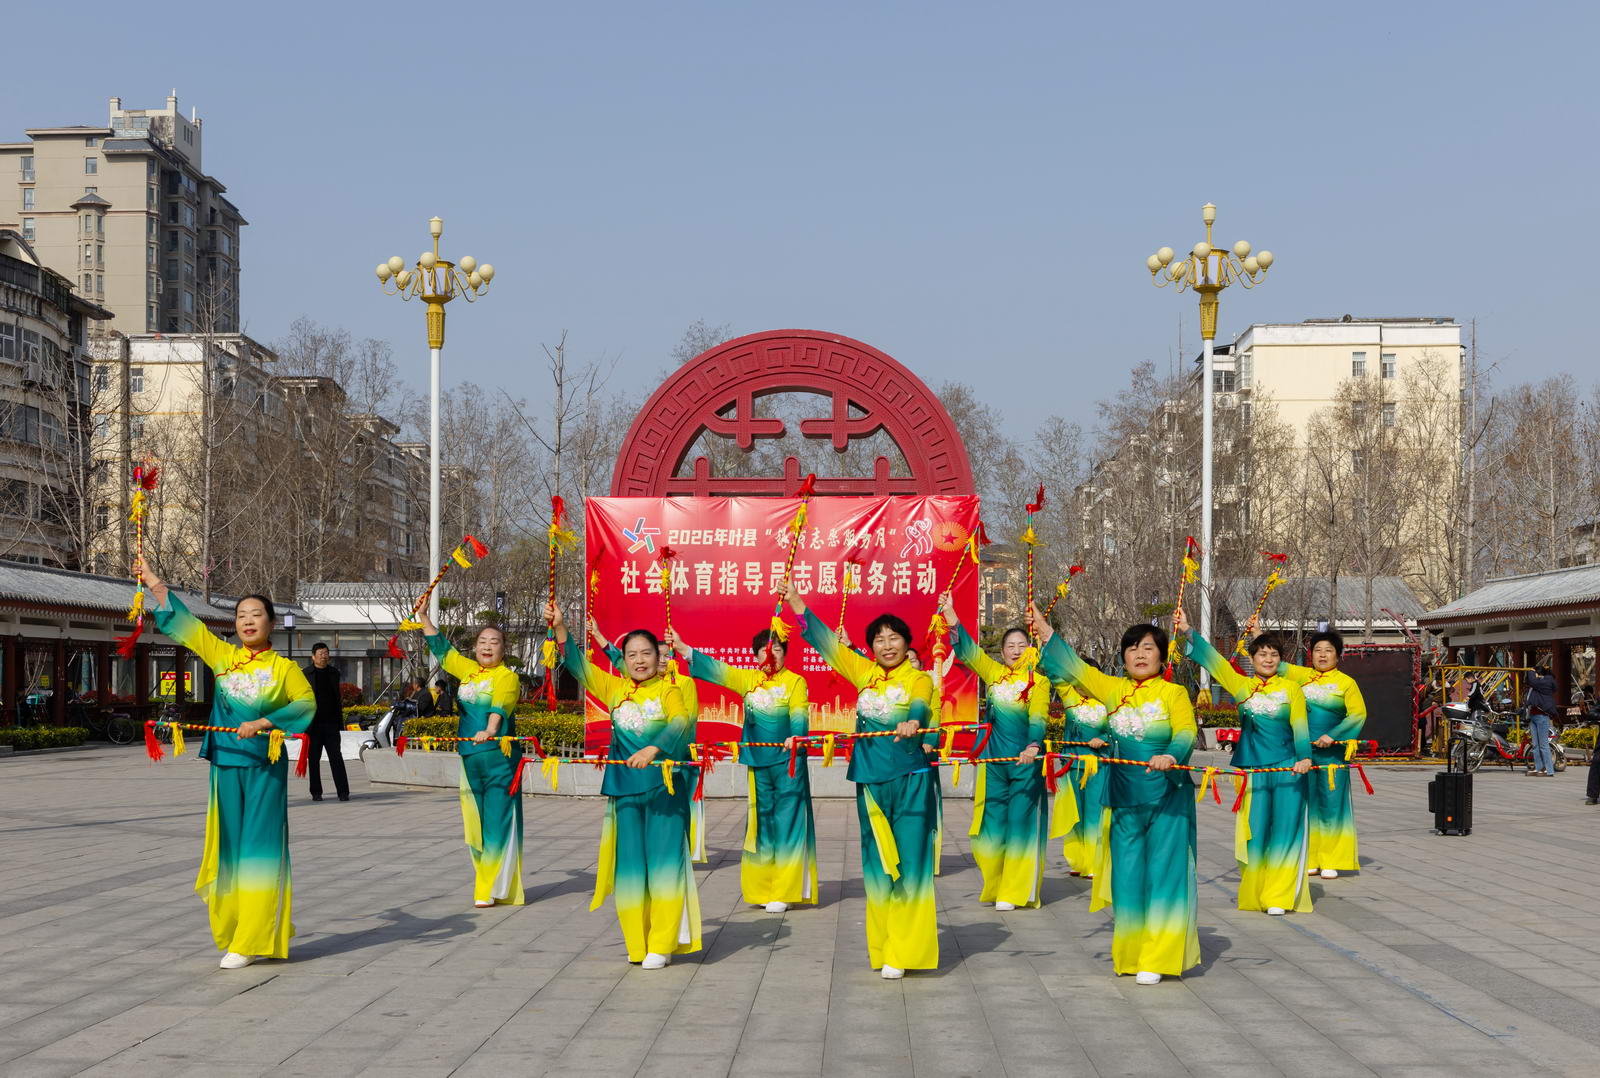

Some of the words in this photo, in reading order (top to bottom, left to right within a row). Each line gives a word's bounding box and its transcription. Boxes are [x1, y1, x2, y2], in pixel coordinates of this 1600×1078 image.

[620, 560, 937, 595] 社会体育指导员志愿服务活动
